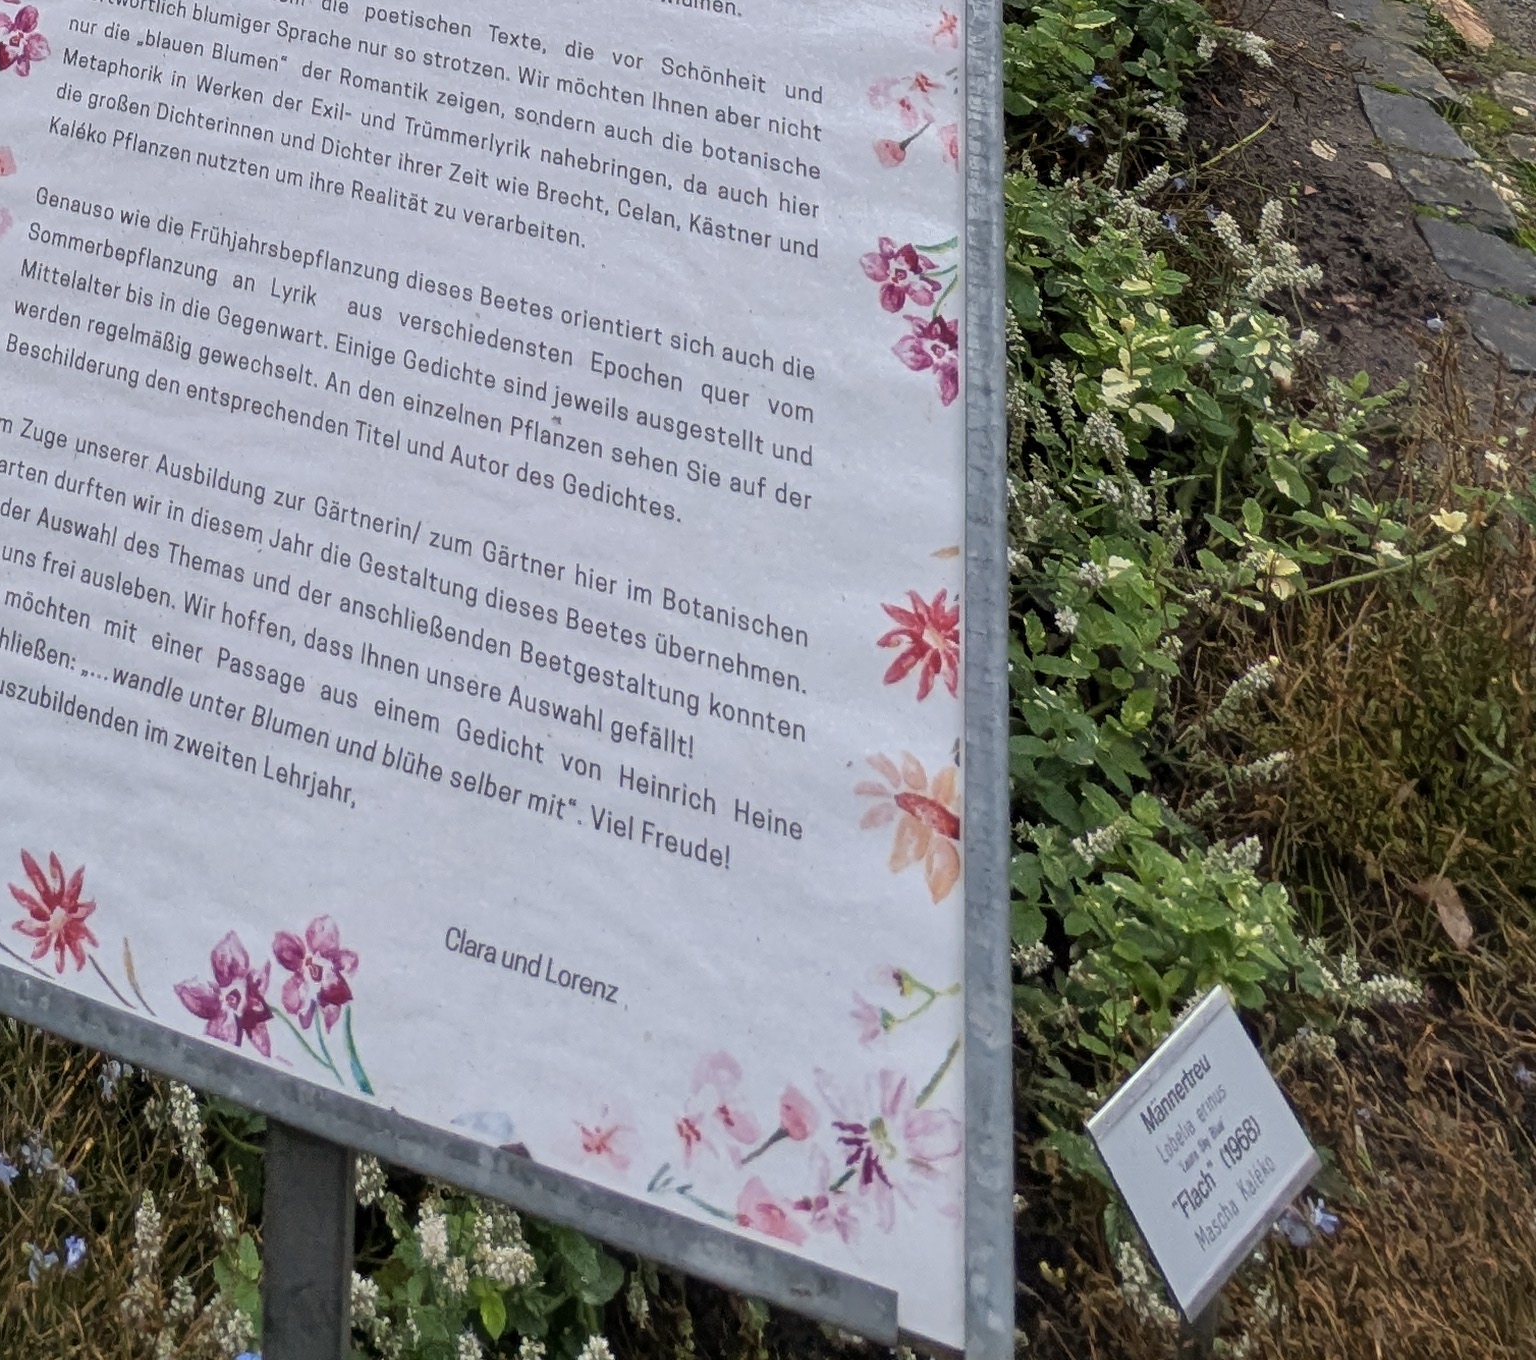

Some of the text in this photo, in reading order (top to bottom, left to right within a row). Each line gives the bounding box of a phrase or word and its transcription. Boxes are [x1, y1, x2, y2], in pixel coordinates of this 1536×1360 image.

[68, 18, 99, 36] nur
[103, 21, 131, 43] die
[301, 60, 333, 82] der
[339, 66, 429, 103] Romantik
[435, 90, 506, 120] zeigen,
[514, 106, 596, 135] sondern
[603, 123, 653, 147] auch
[661, 130, 694, 155] die
[701, 137, 821, 181] botanische
[364, 5, 472, 39] poetischen
[488, 23, 547, 55] Texte,
[564, 39, 595, 61] die
[611, 51, 645, 70] vor
[660, 56, 767, 95] Schönheit
[784, 84, 823, 105] und
[48, 115, 586, 249] Kaléko Pflanzen nutzten um ihre Realität zu verarbeiten.
[27, 221, 814, 425] Sommerbepflanzung an Lyrik aus verschiedensten Epochen quer vom
[5, 332, 682, 524] Beschilderung den entsprechenden Titel und Autor des Gedichtes.
[0, 496, 32, 523] der
[35, 506, 119, 548] Auswahl
[123, 530, 160, 560] des
[168, 540, 246, 584] Themas
[252, 571, 292, 597] und
[297, 579, 333, 608] der
[338, 596, 512, 659] anschließenden
[519, 639, 700, 718] Beetgestaltung
[709, 691, 806, 743] konnten
[143, 718, 169, 748] im
[172, 733, 258, 776] zweiten
[262, 754, 357, 810] Lehrjahr,
[188, 690, 247, 723] unter
[250, 703, 330, 749] Blumen
[335, 735, 379, 763] und
[381, 742, 444, 783] blühe
[449, 770, 523, 806] selber
[590, 803, 635, 841] Viel
[641, 819, 731, 871] Freude!
[444, 925, 620, 1005] Clara und Lorenz
[1139, 1055, 1211, 1134] Männertreu
[1156, 1084, 1227, 1164] Lobelia erinus
[1172, 1115, 1262, 1219] "Flach" (1968)
[1194, 1200, 1240, 1253] Mascha
